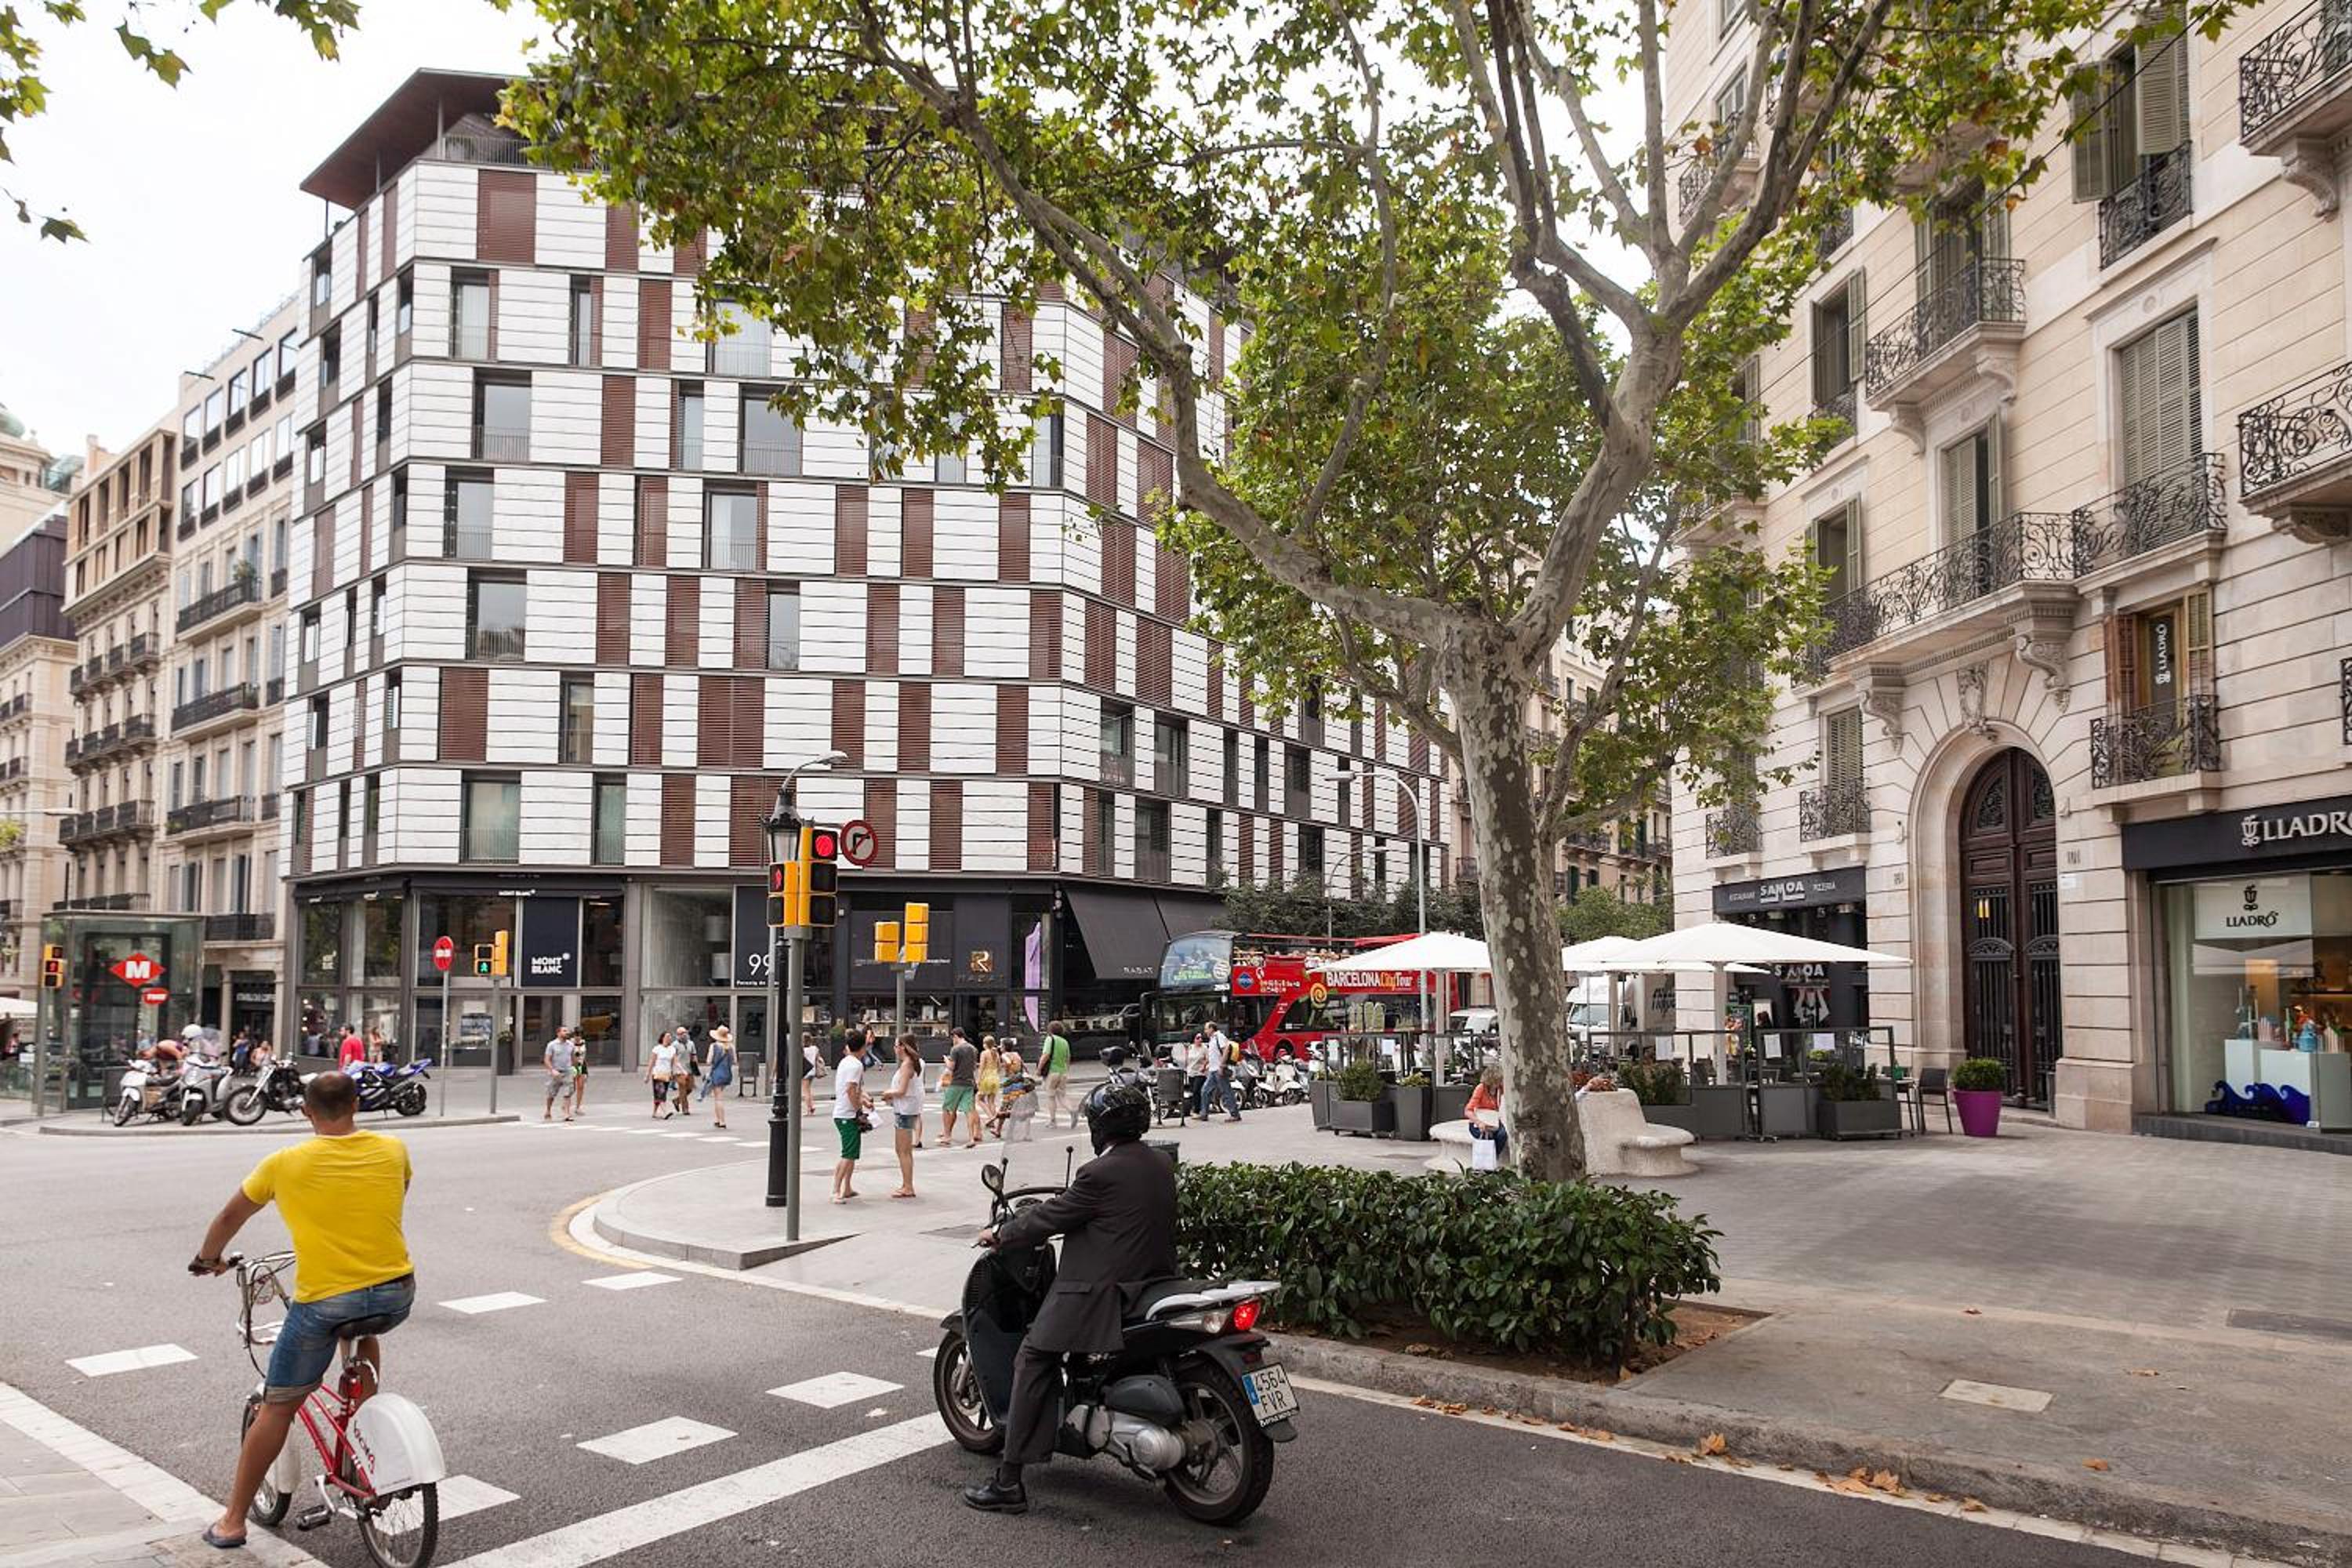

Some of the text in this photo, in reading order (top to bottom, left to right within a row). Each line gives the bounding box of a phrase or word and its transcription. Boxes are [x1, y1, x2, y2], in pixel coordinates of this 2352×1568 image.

[2263, 811, 2352, 840] LLADR
[1760, 881, 1806, 902] SAMOA
[2226, 911, 2278, 927] LLADRÓ
[125, 960, 151, 979] M
[532, 956, 562, 966] MONT
[531, 965, 562, 975] BLANC
[1327, 971, 1380, 987] BARCELONA
[1255, 1369, 1286, 1392] 4564
